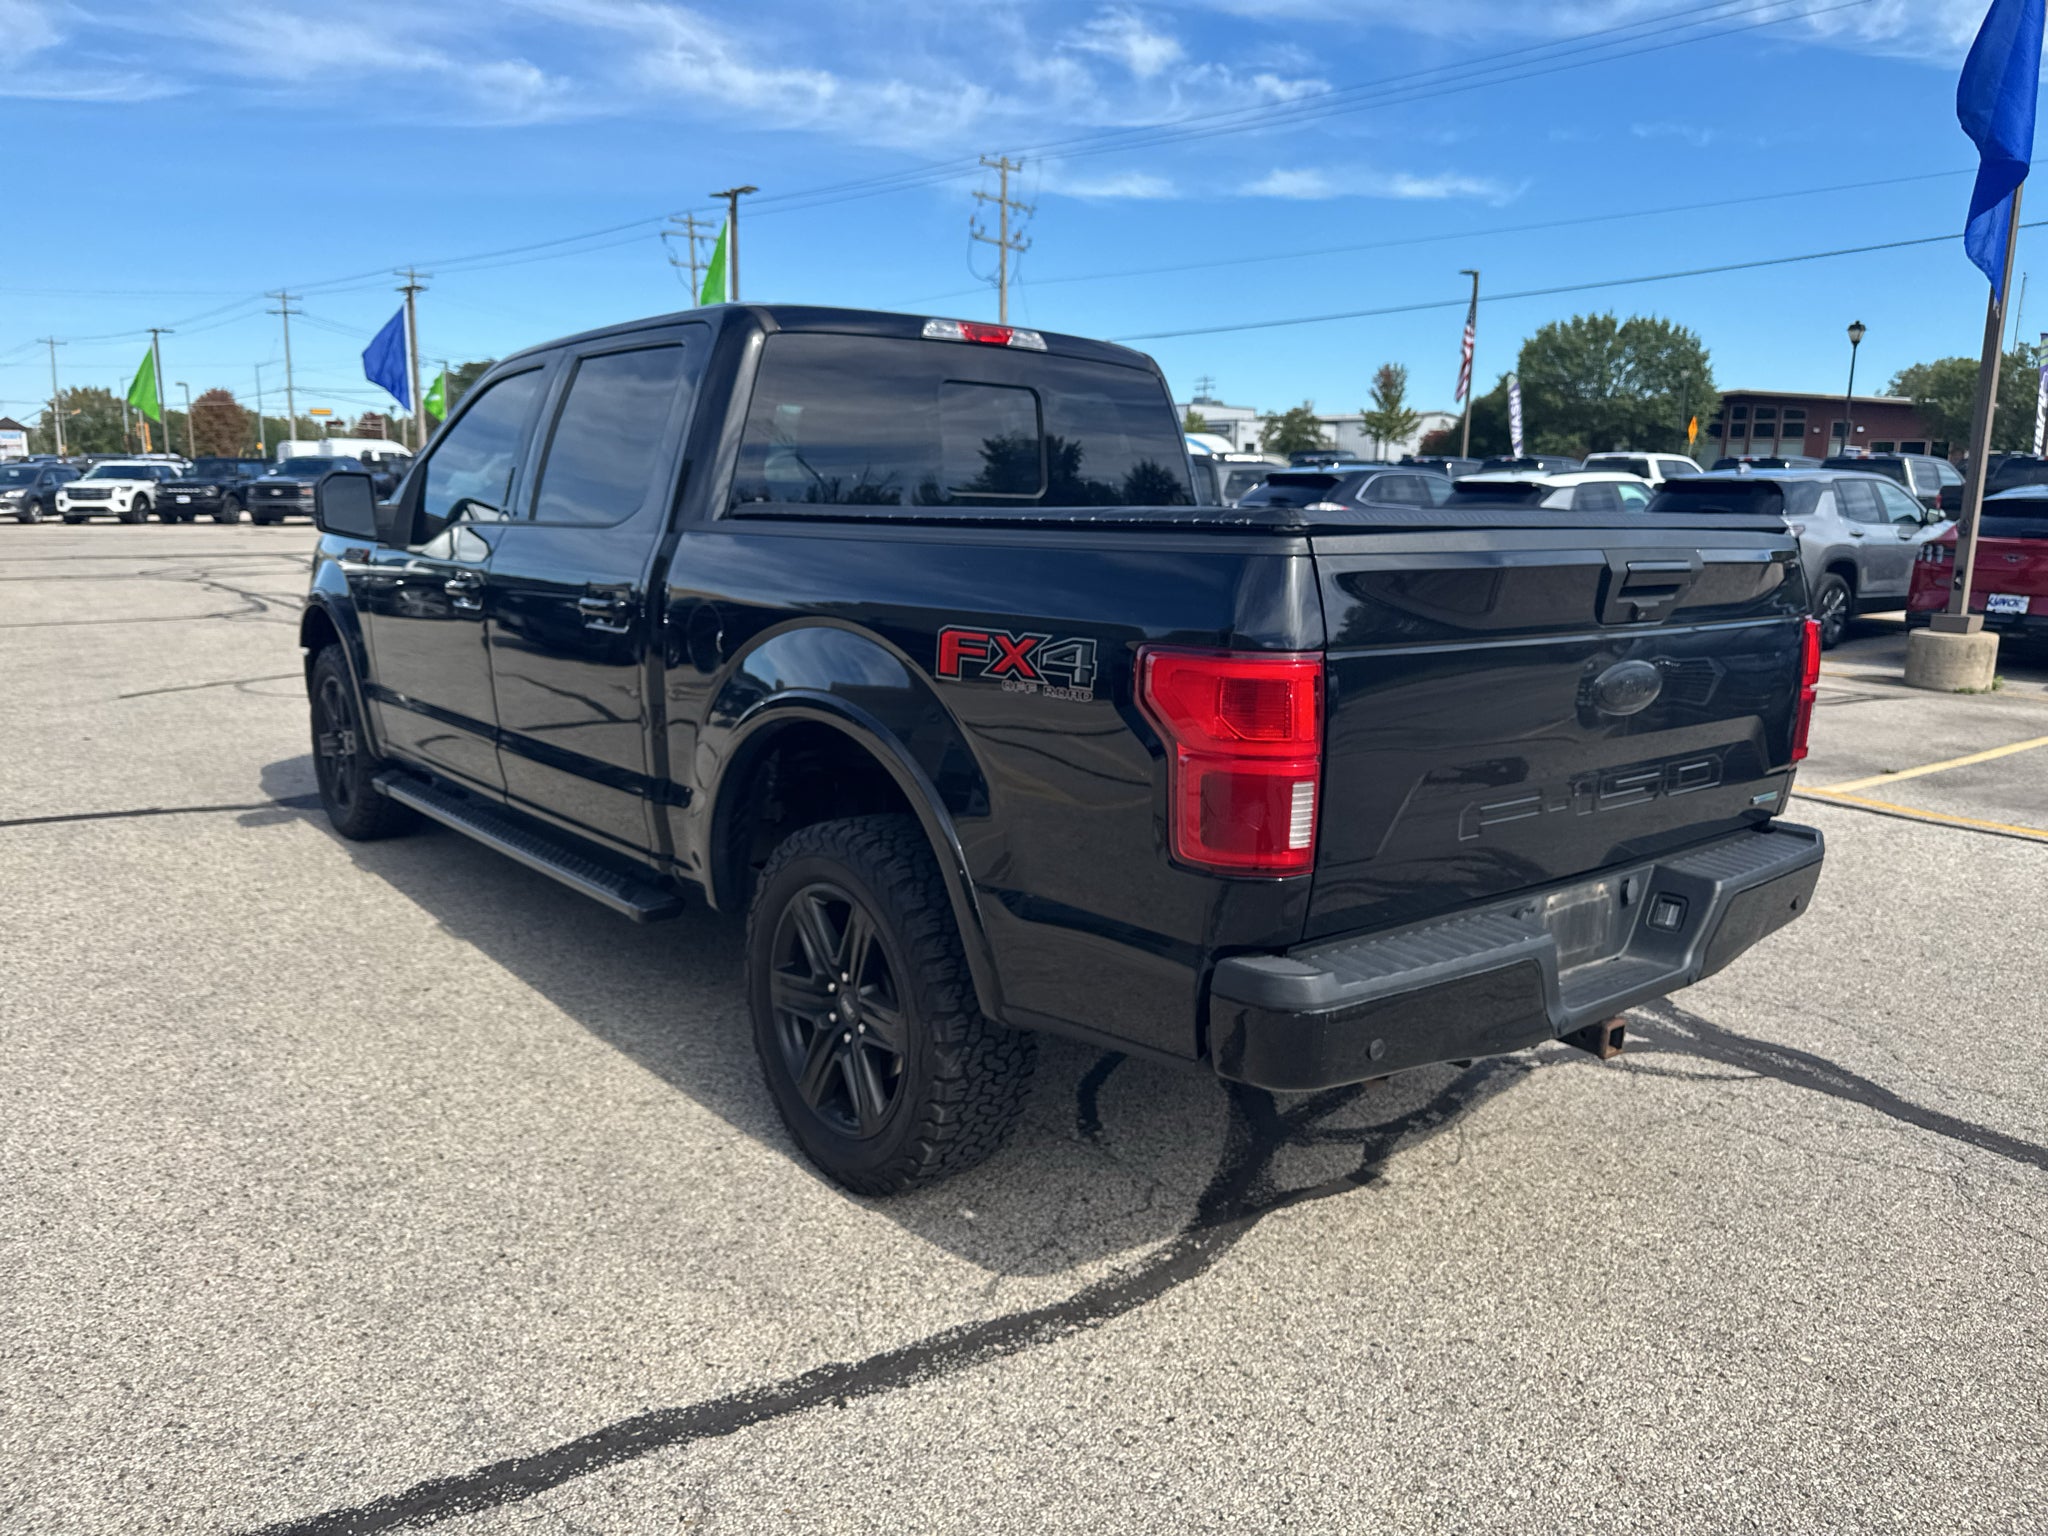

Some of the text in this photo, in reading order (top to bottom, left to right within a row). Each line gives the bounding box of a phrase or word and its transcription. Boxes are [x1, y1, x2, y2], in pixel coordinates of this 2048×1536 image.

[936, 624, 1097, 690] FX4
[1001, 680, 1093, 702] OFF ROAD
